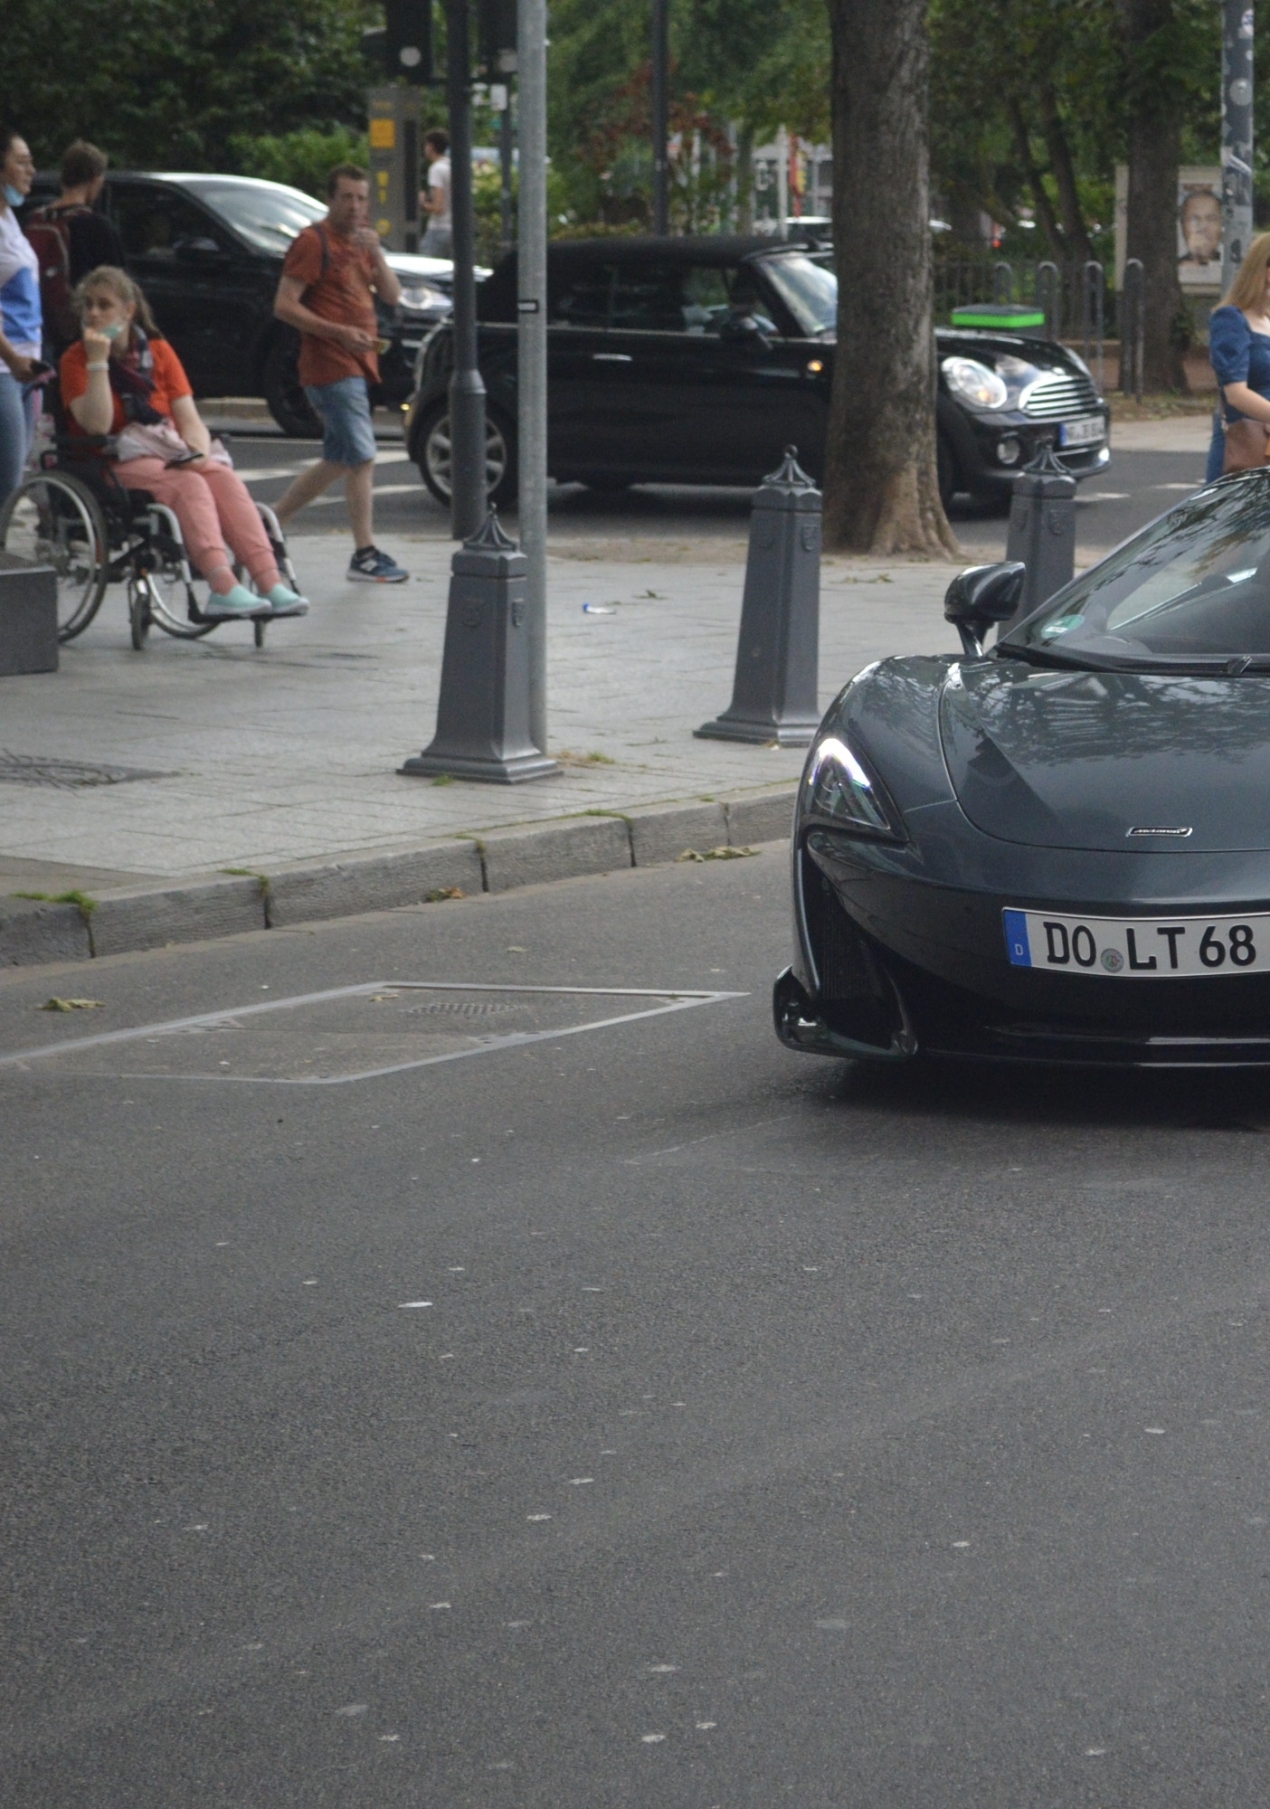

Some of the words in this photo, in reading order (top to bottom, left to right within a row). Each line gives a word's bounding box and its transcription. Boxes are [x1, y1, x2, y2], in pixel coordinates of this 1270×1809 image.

[1014, 943, 1024, 956] D
[1043, 921, 1097, 967] DO
[1126, 926, 1186, 970] LT
[1199, 925, 1257, 968] 68
